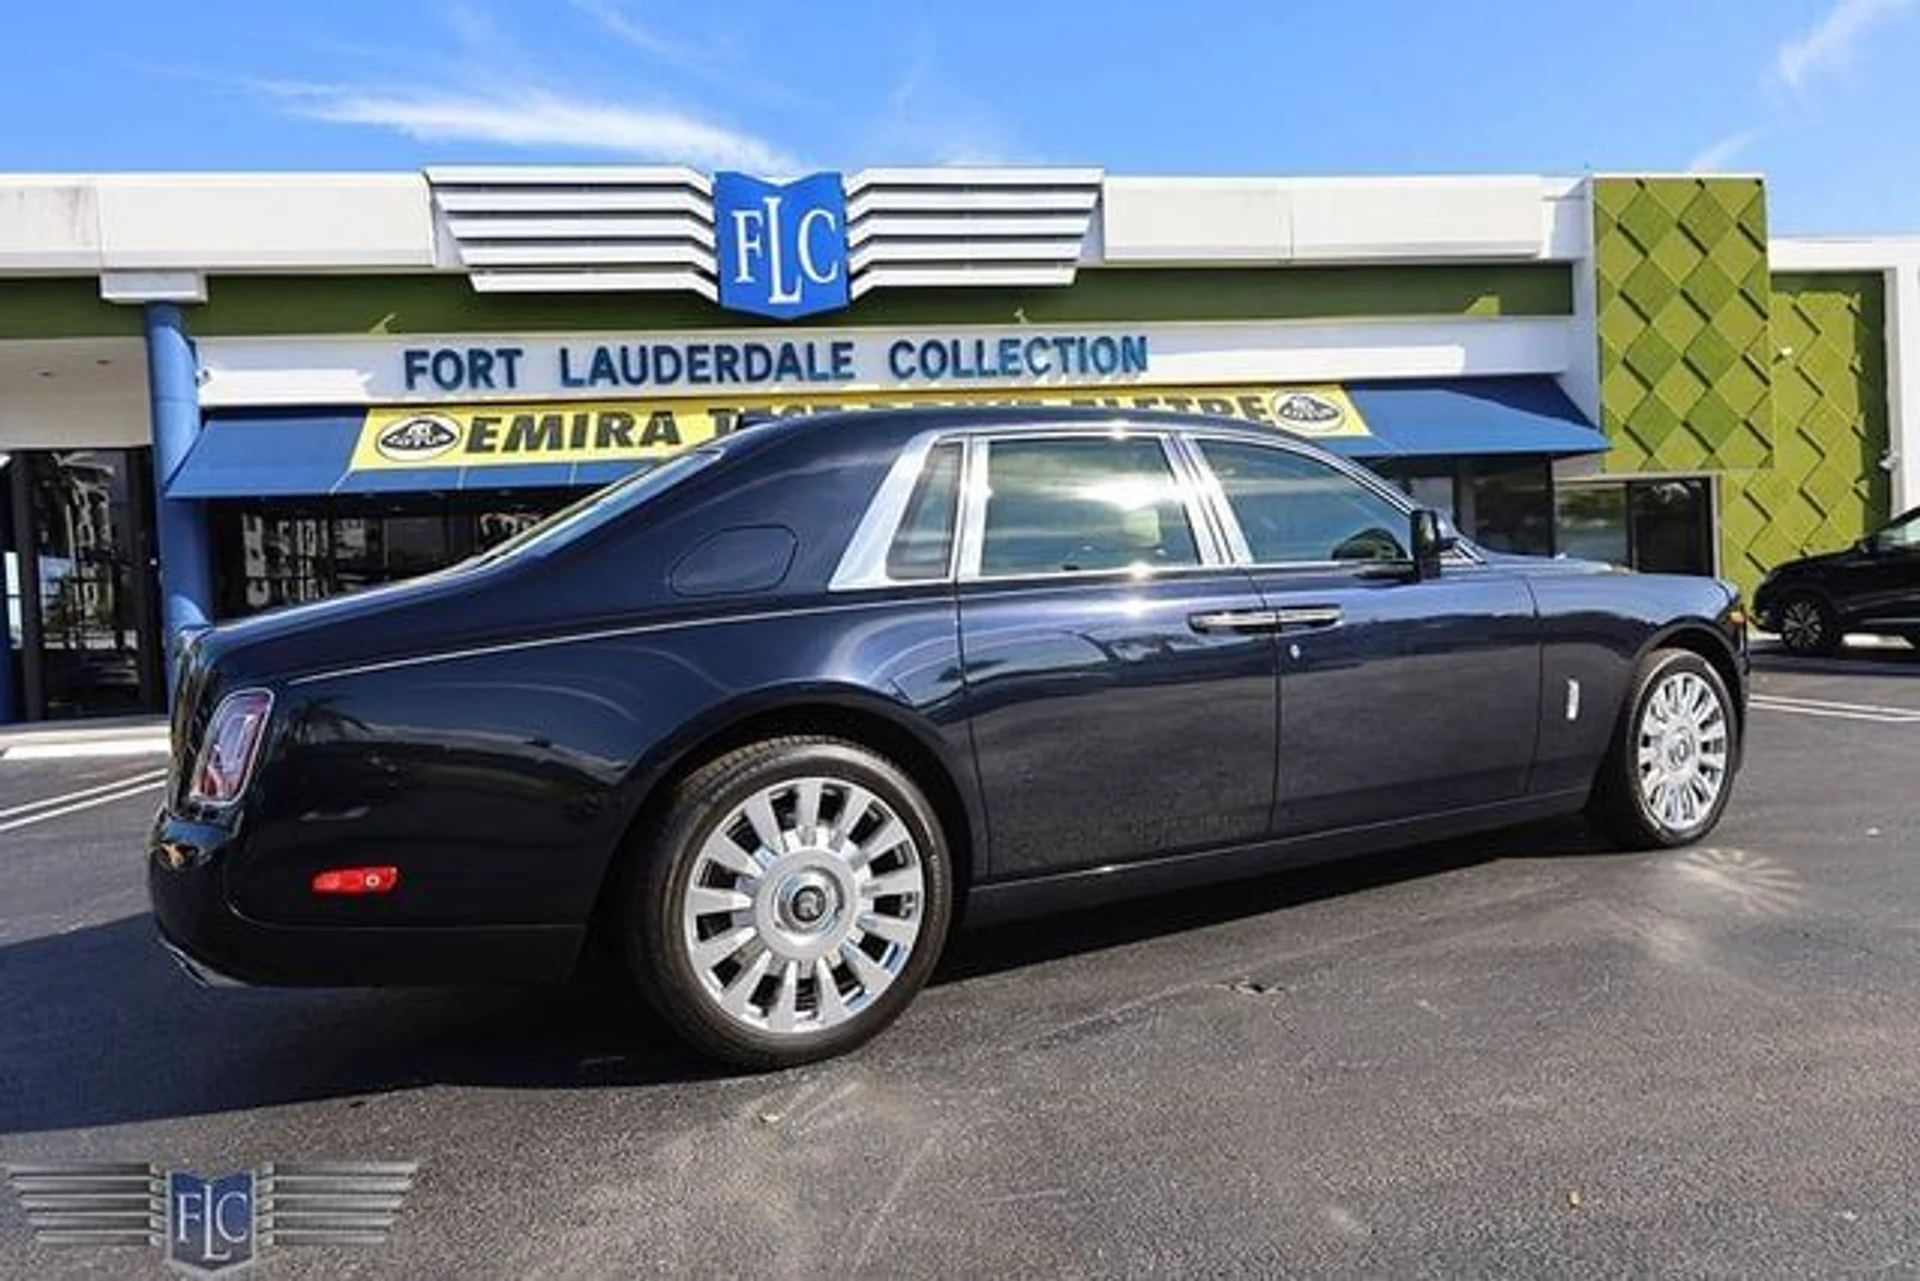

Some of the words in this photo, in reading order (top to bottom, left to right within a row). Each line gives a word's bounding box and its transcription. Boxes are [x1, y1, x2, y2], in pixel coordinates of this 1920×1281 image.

[731, 197, 839, 303] FLC
[404, 349, 522, 391] FORT
[560, 342, 854, 387] LAUDERDALE
[889, 336, 1148, 379] COLLECTION
[465, 411, 681, 454] EMIRA
